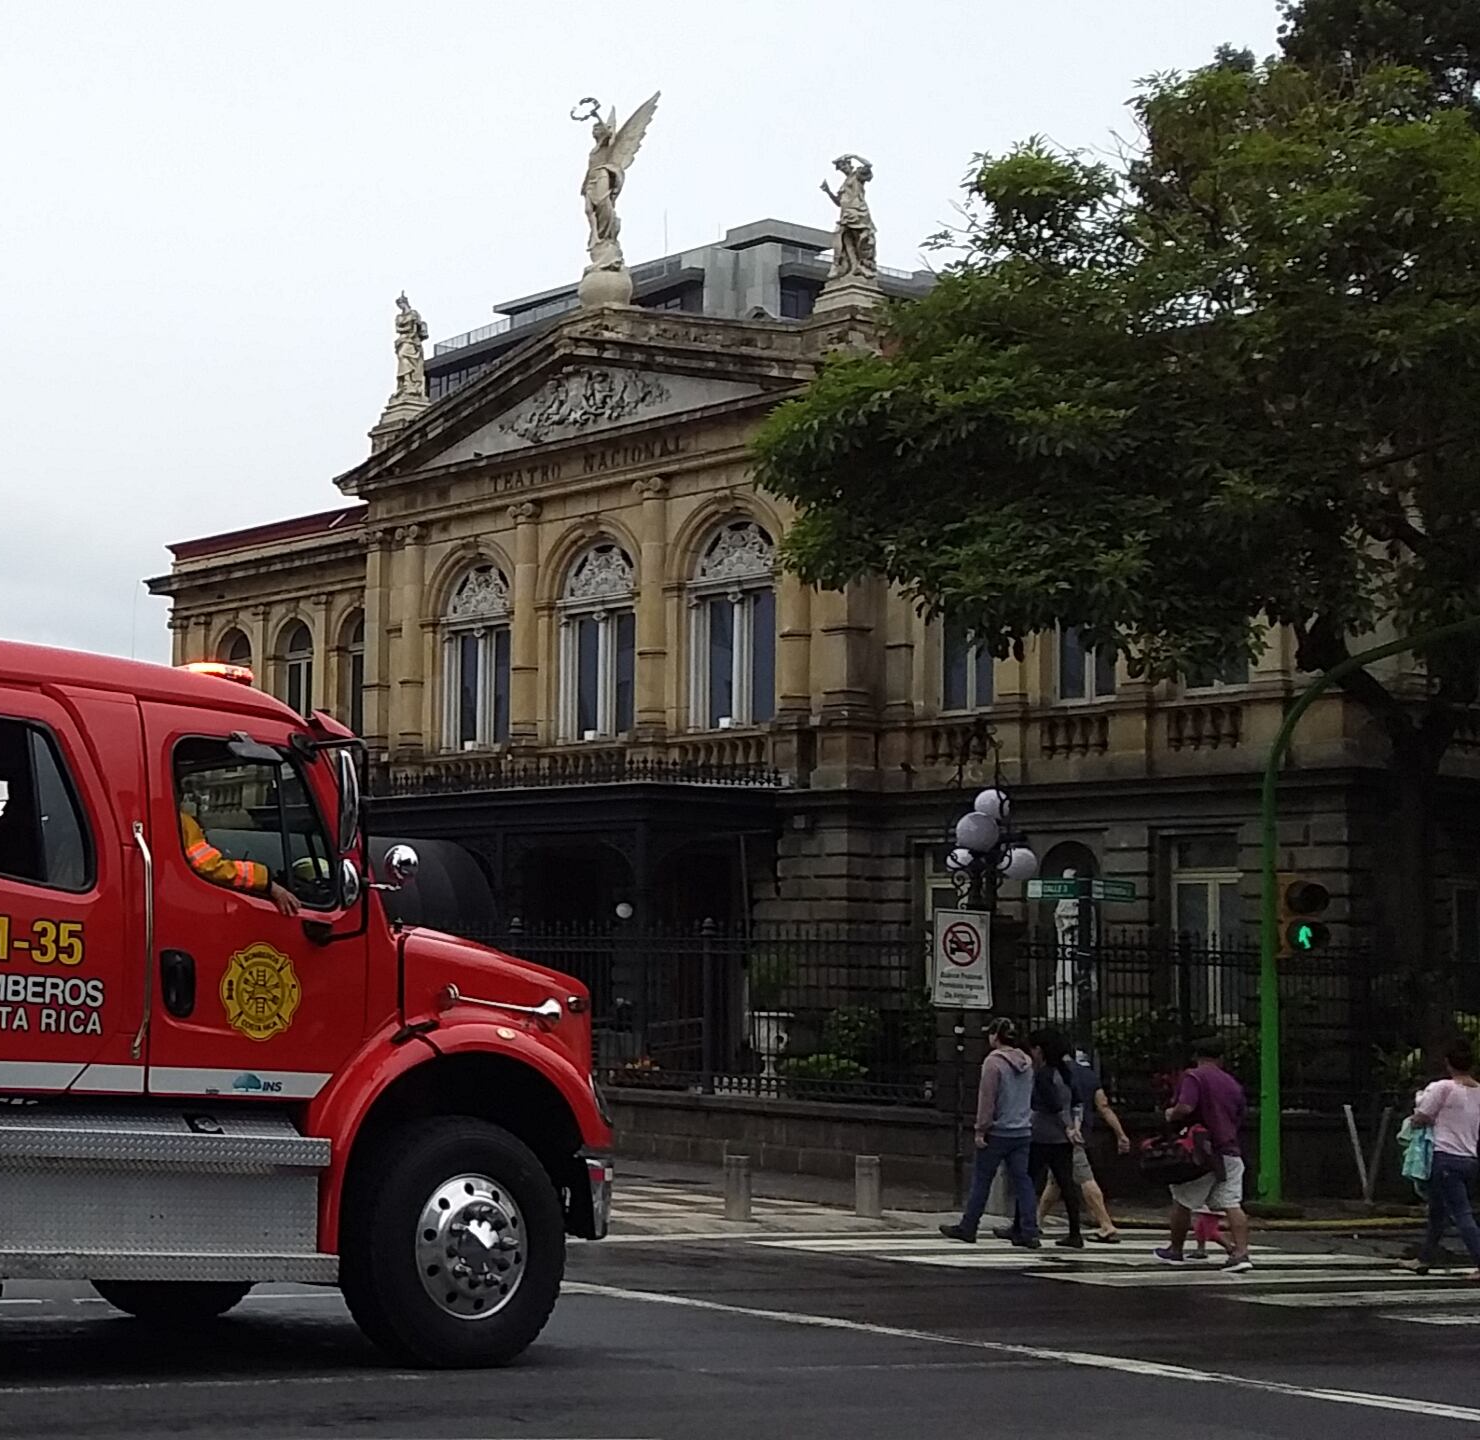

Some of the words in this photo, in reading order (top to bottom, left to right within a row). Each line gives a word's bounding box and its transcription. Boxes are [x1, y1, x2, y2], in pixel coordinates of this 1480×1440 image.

[490, 464, 562, 493] TEATRO
[583, 436, 686, 474] NACIONAL
[40, 1008, 102, 1035] RICA
[262, 1081, 283, 1092] INS
